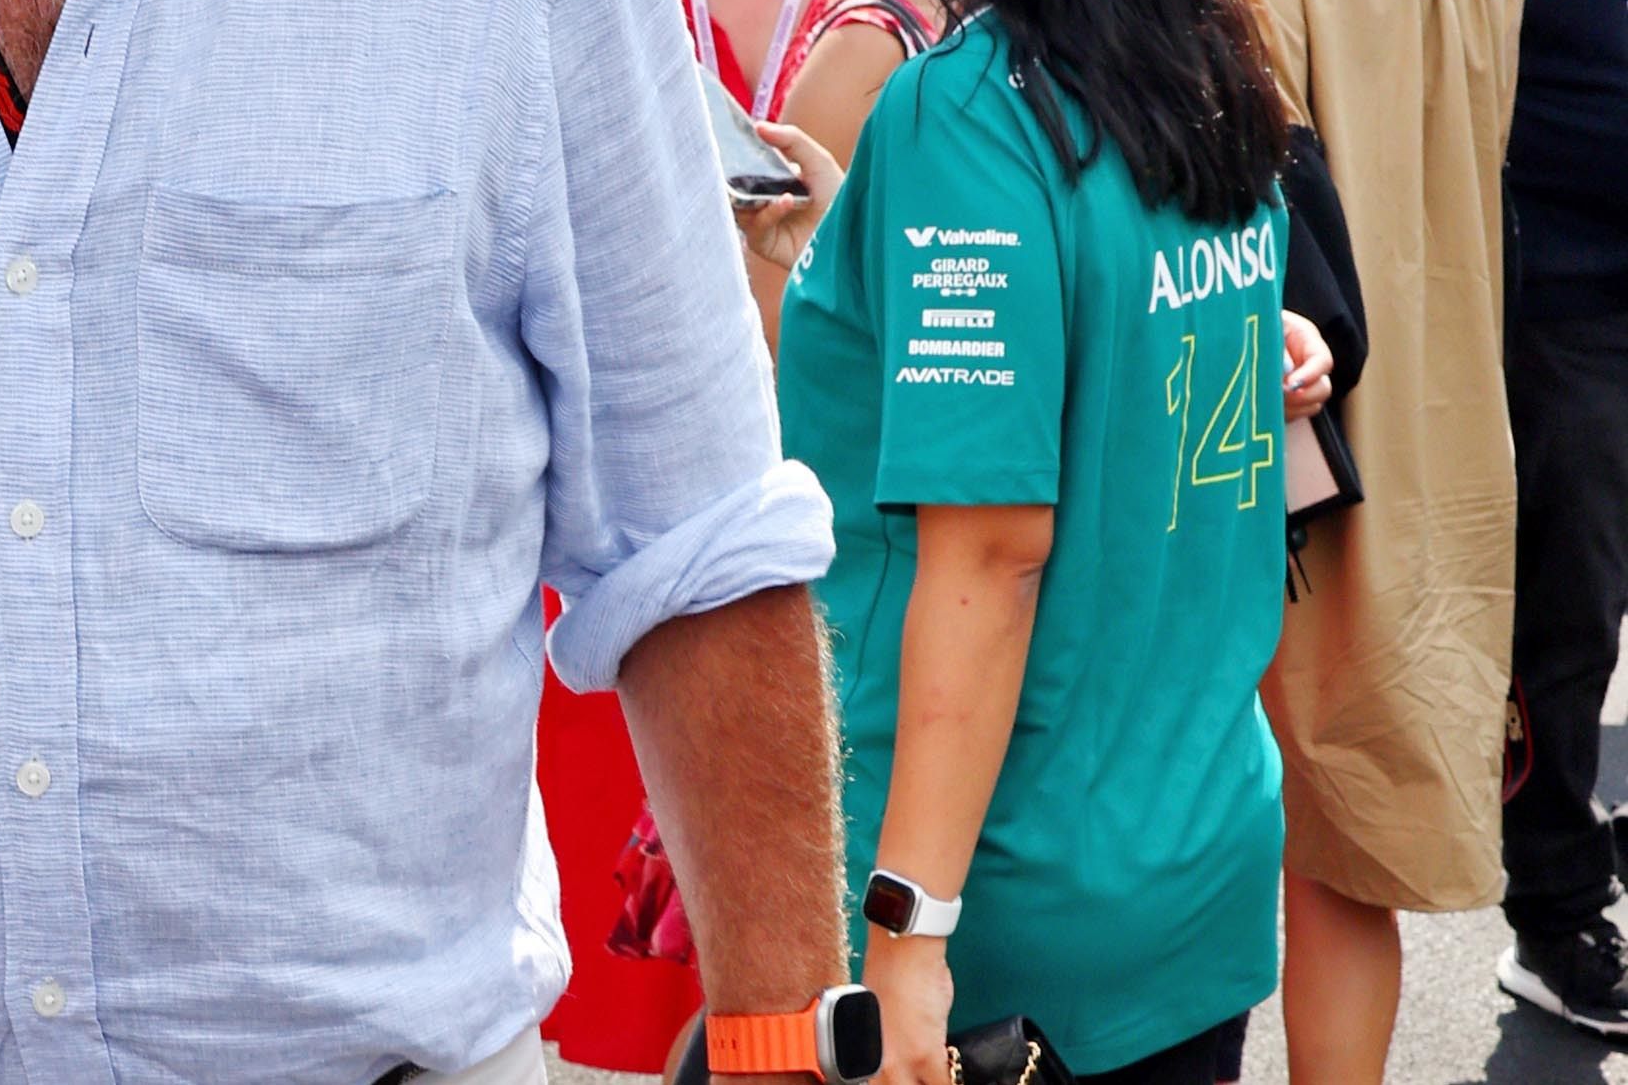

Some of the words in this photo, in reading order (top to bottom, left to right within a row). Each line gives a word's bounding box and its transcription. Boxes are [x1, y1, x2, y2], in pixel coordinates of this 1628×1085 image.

[931, 258, 990, 273] GIRARD
[1148, 220, 1277, 314] ALONSO
[912, 273, 1008, 289] PERREGAUX
[922, 309, 996, 328] PIRELLI
[908, 339, 1005, 358] BOMBARDIER
[895, 367, 1015, 386] AVATRADE
[1167, 315, 1273, 532] 14
